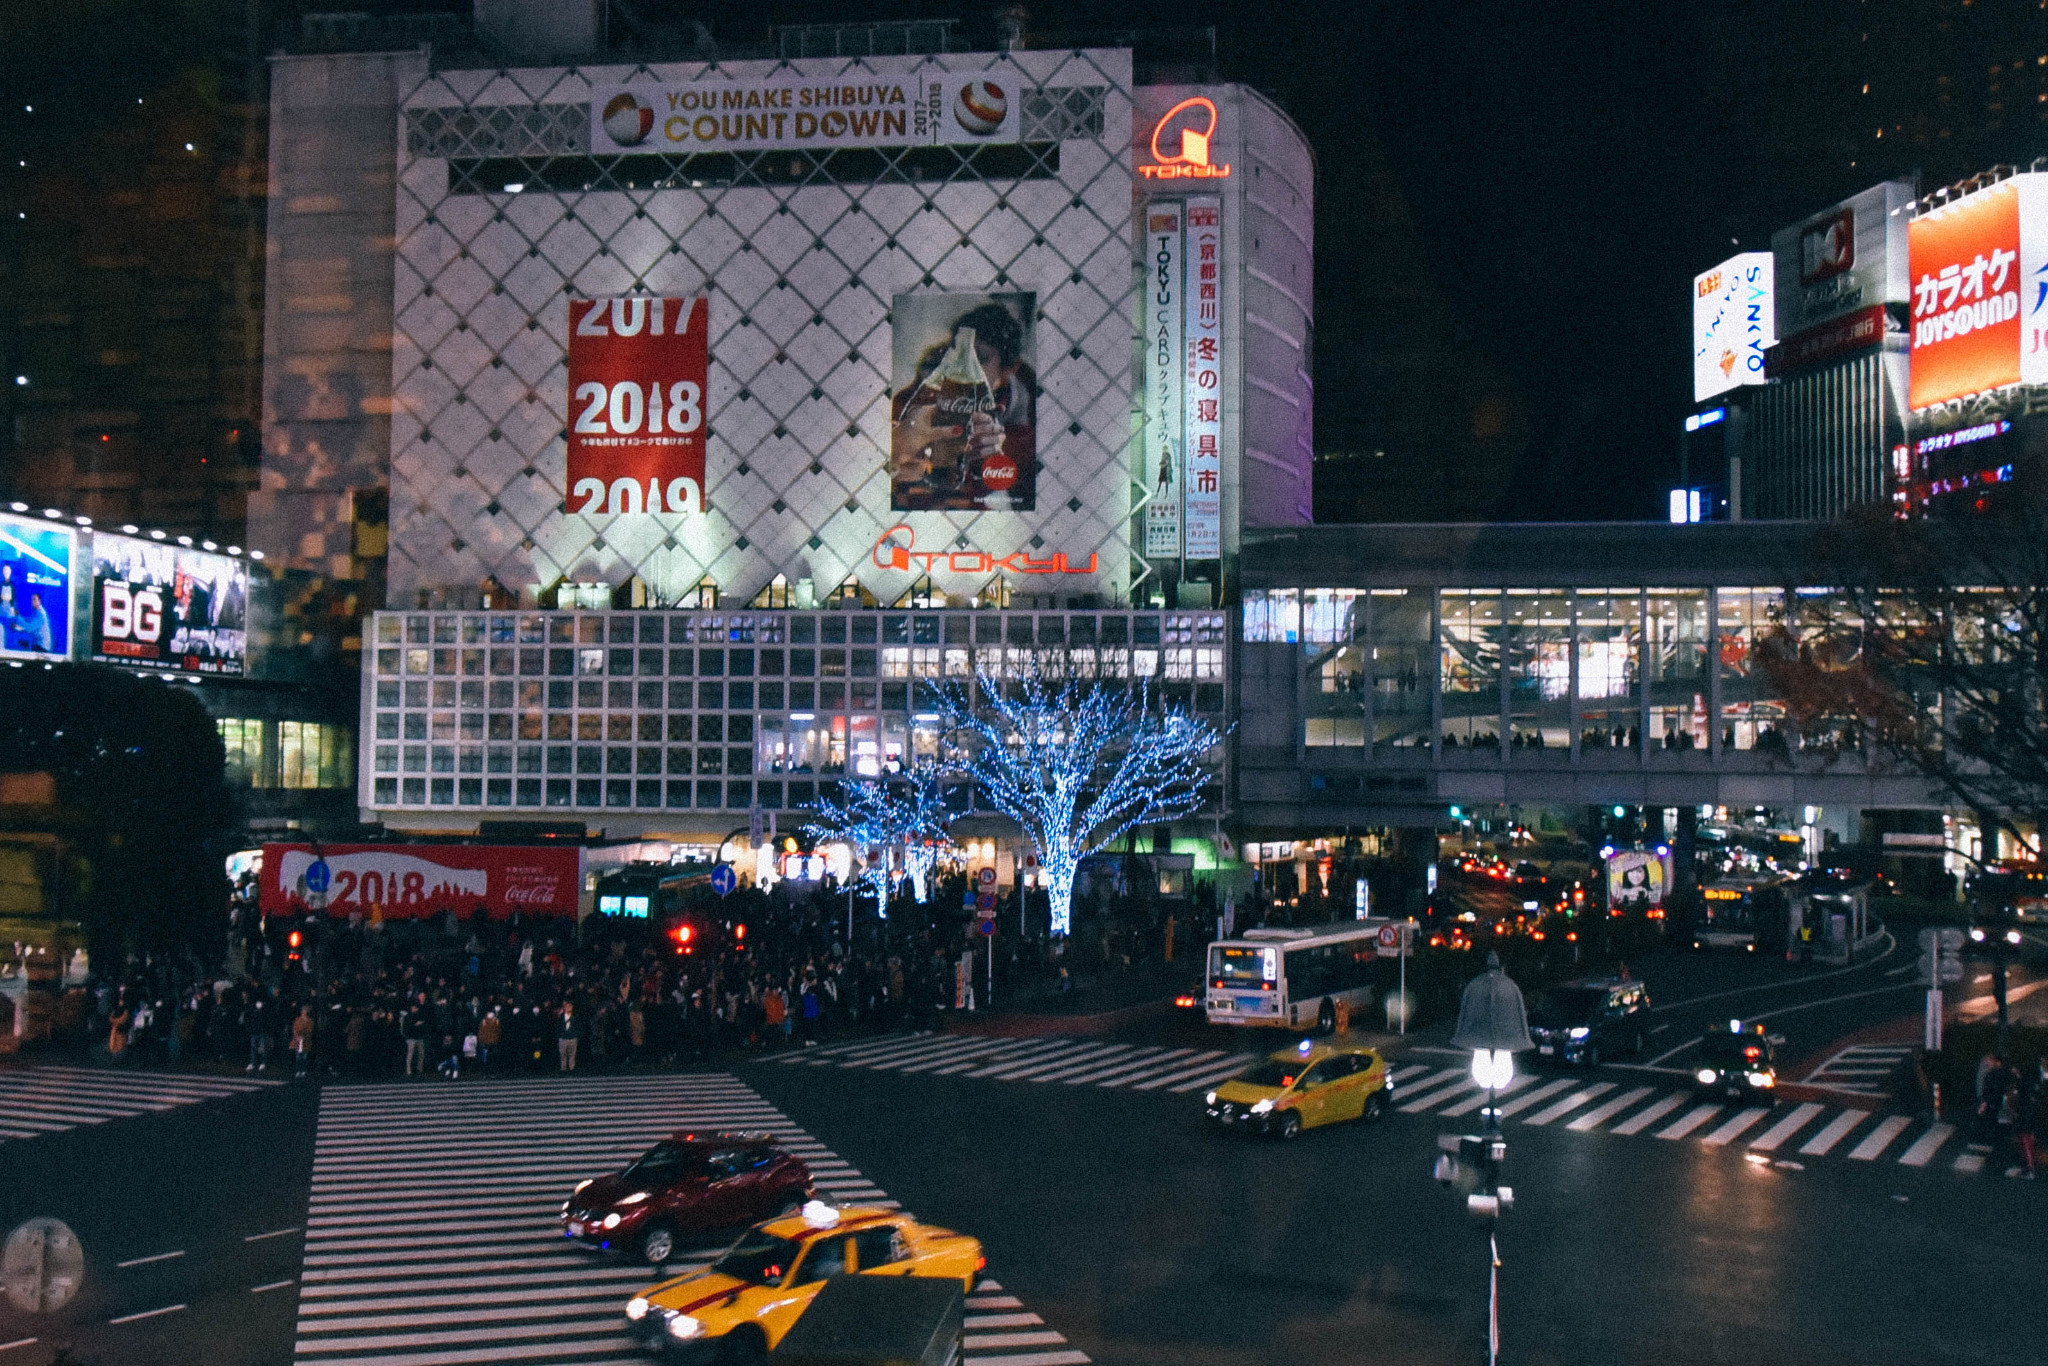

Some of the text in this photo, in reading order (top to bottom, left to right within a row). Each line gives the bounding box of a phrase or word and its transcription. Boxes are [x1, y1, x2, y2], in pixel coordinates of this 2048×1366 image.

[665, 84, 906, 112] YOU MAKE SHIBUYA
[928, 83, 942, 118] 2018
[914, 99, 928, 137] 2017
[1138, 163, 1231, 179] TOKYU
[1157, 237, 1170, 305] TOKYU
[1914, 248, 2016, 319] カラオケ
[576, 298, 697, 336] 2017
[1746, 266, 1766, 372] SANKYO
[1914, 291, 2018, 350] JOYSOUND
[1157, 311, 1170, 367] CARD
[574, 381, 701, 434] 2018
[573, 477, 701, 514] 2019
[909, 552, 1098, 574] TOKYU
[102, 584, 163, 643] BG
[334, 870, 425, 904] 2018
